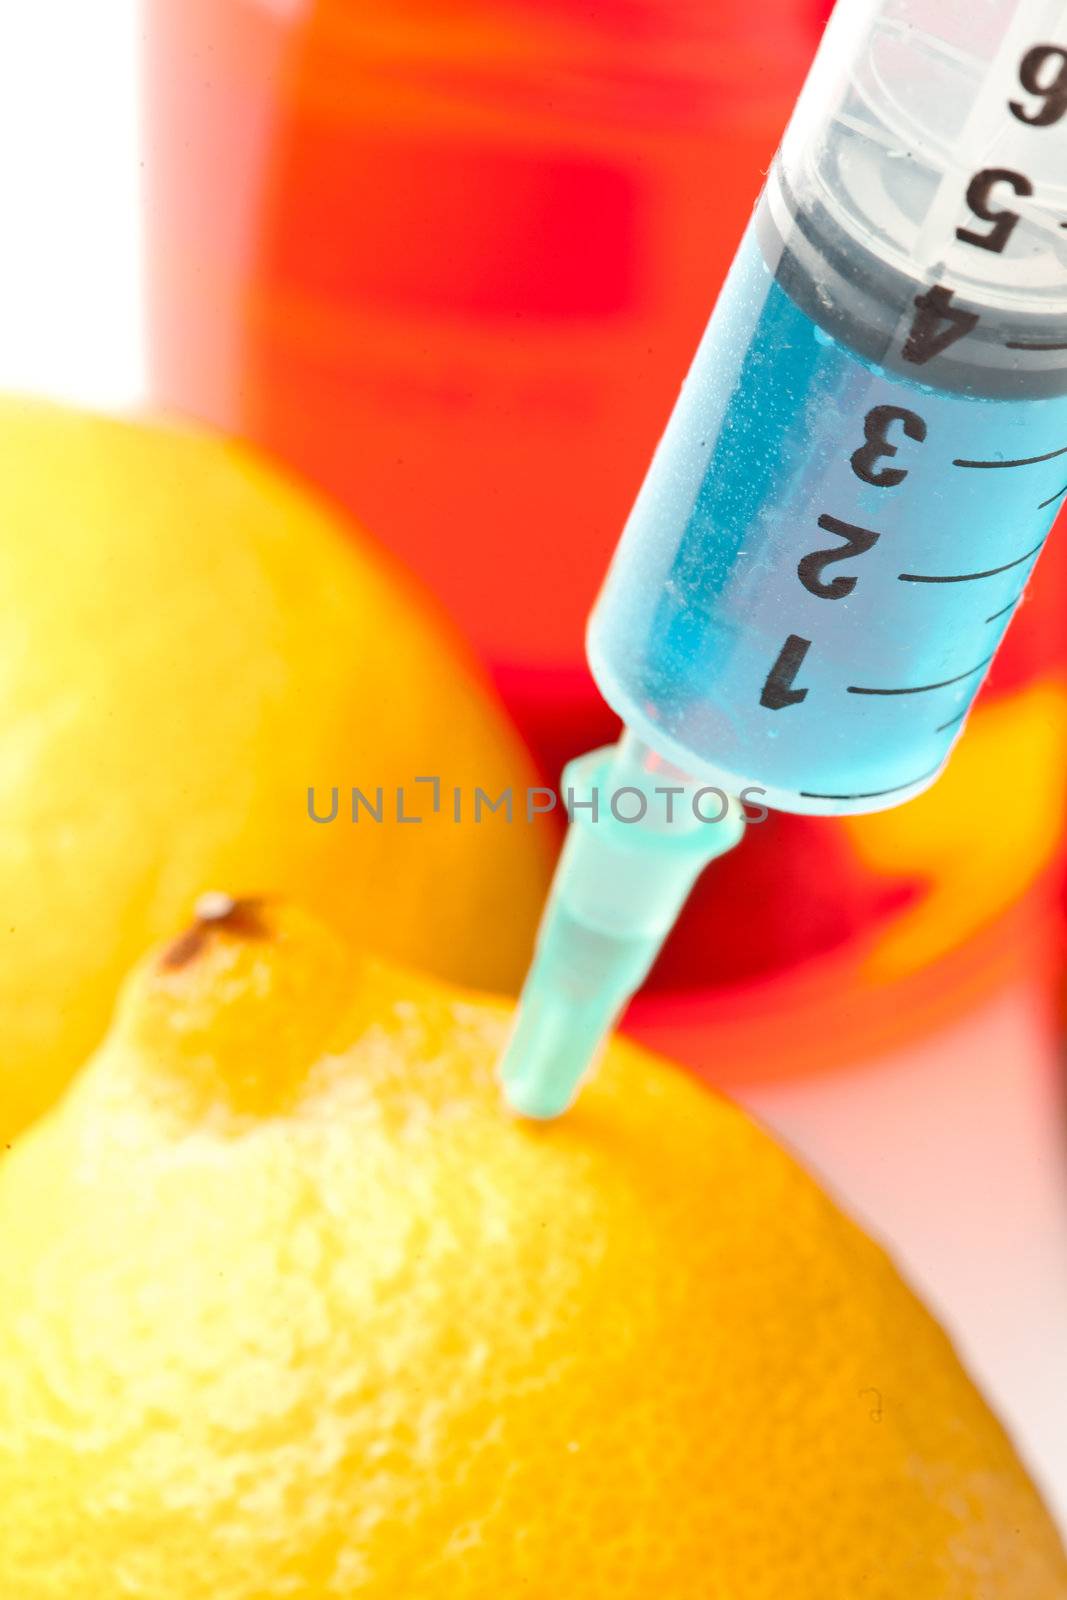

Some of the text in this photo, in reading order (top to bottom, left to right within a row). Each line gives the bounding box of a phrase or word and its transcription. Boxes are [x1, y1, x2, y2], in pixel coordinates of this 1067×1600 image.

[955, 168, 1033, 253] 5
[901, 284, 980, 365] 4
[850, 404, 927, 488] 3
[797, 513, 880, 600] 2
[759, 634, 812, 710] 1
